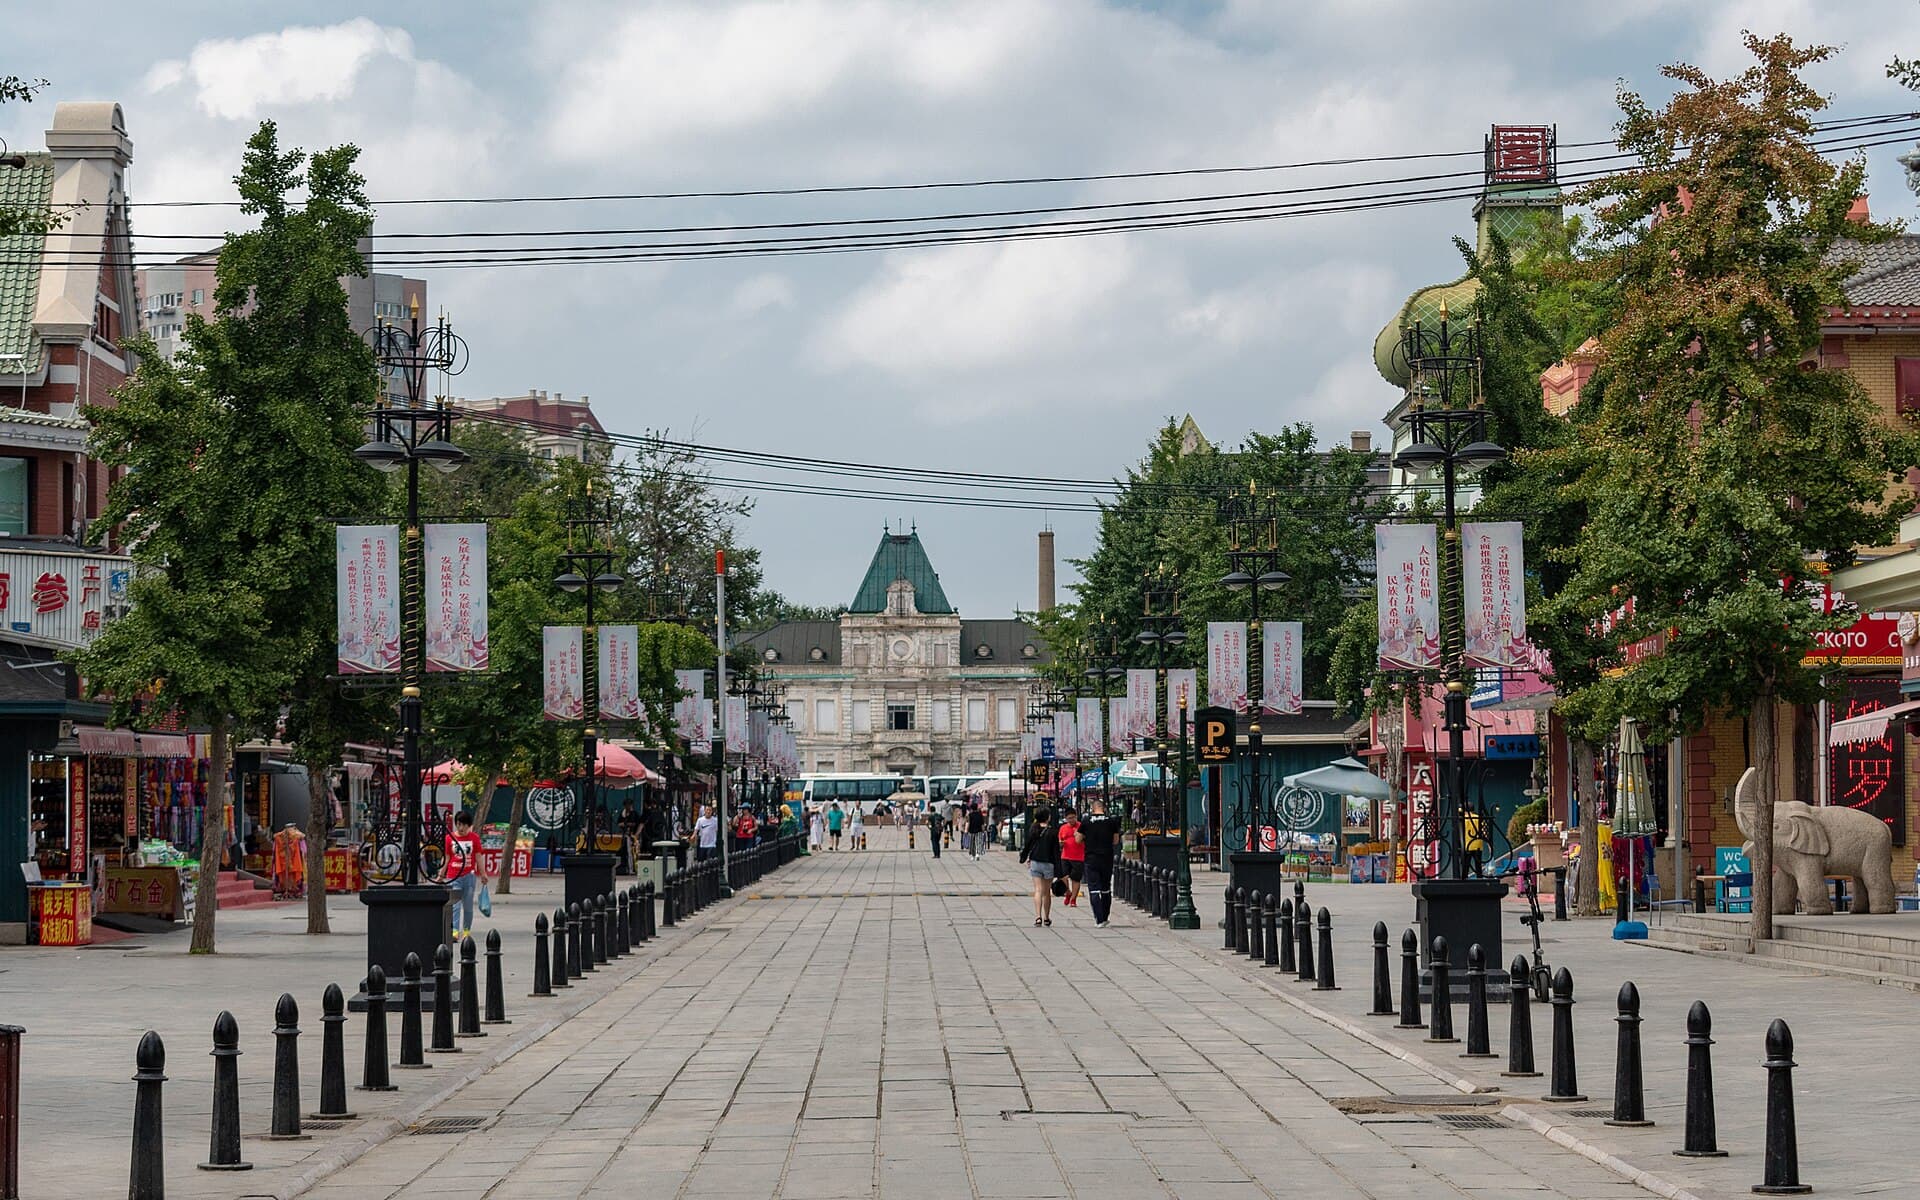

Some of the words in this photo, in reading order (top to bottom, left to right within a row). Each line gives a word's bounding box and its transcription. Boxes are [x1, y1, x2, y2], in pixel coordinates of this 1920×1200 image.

[458, 537, 470, 587] 发展为了人民
[1419, 545, 1431, 599] 人民有信仰
[1497, 546, 1512, 628] 学习贯彻党的十九大精神
[81, 565, 101, 629] 工厂店
[440, 556, 453, 631] 发展成果由人民共享
[1387, 576, 1400, 627] 民族有希望
[1403, 562, 1414, 616] 国家有力量
[1888, 632, 1903, 648] С
[1201, 745, 1231, 754] 停车场
[1207, 721, 1225, 746] P
[1034, 765, 1047, 775] WC
[1844, 699, 1893, 823] 俄罗
[1723, 851, 1741, 861] WC
[43, 889, 74, 916] 俄罗斯
[106, 878, 164, 905] 矿石金
